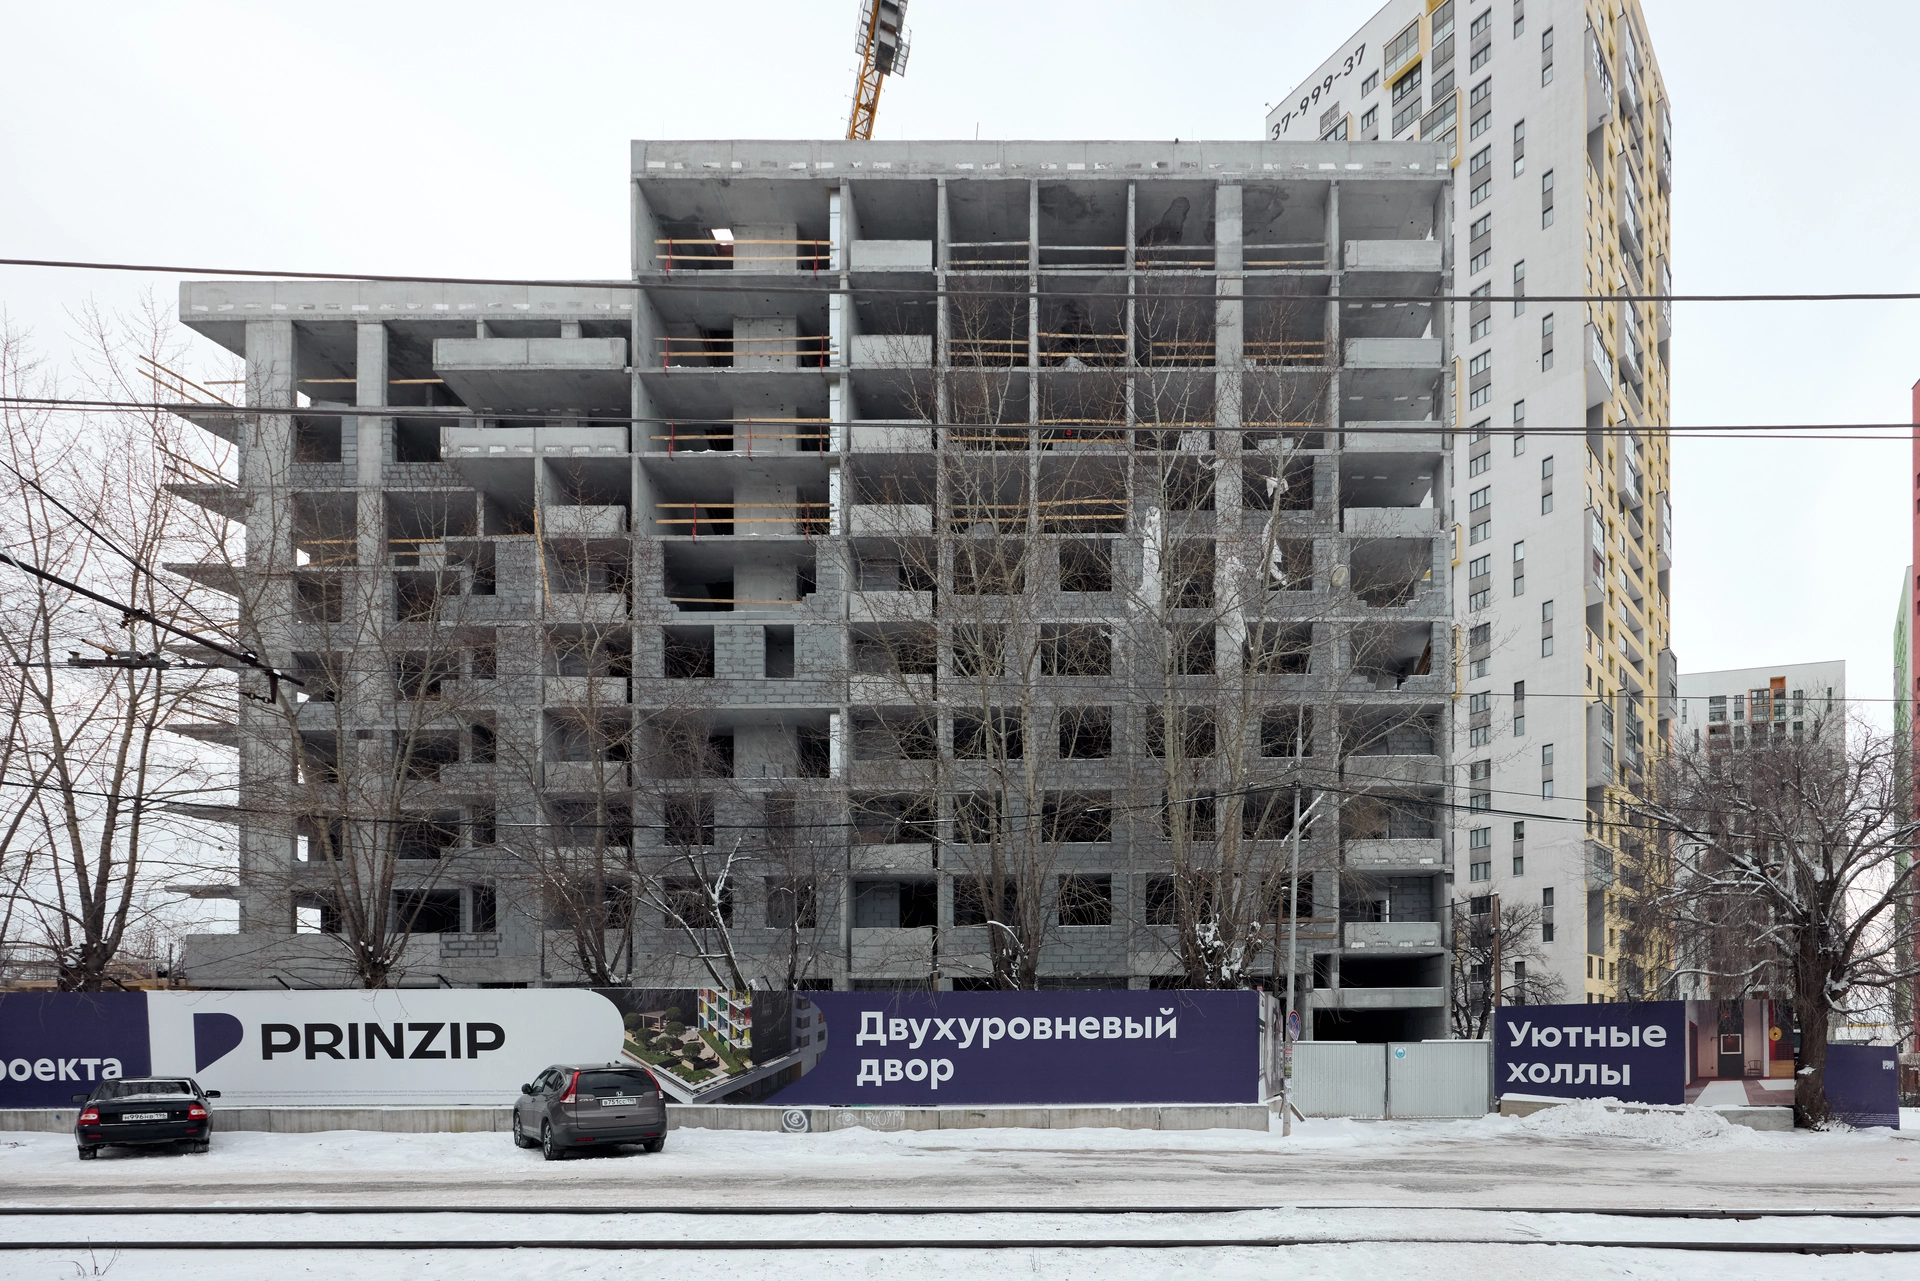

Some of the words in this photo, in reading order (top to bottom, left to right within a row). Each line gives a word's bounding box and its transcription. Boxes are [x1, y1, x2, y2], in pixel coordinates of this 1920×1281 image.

[1271, 42, 1366, 141] 37-999-37
[262, 1022, 506, 1060] PRINZIP
[856, 1008, 1177, 1050] Двухуровневый
[1506, 1022, 1667, 1048] Уютные
[856, 1058, 955, 1090] двор
[1506, 1062, 1630, 1086] холлы
